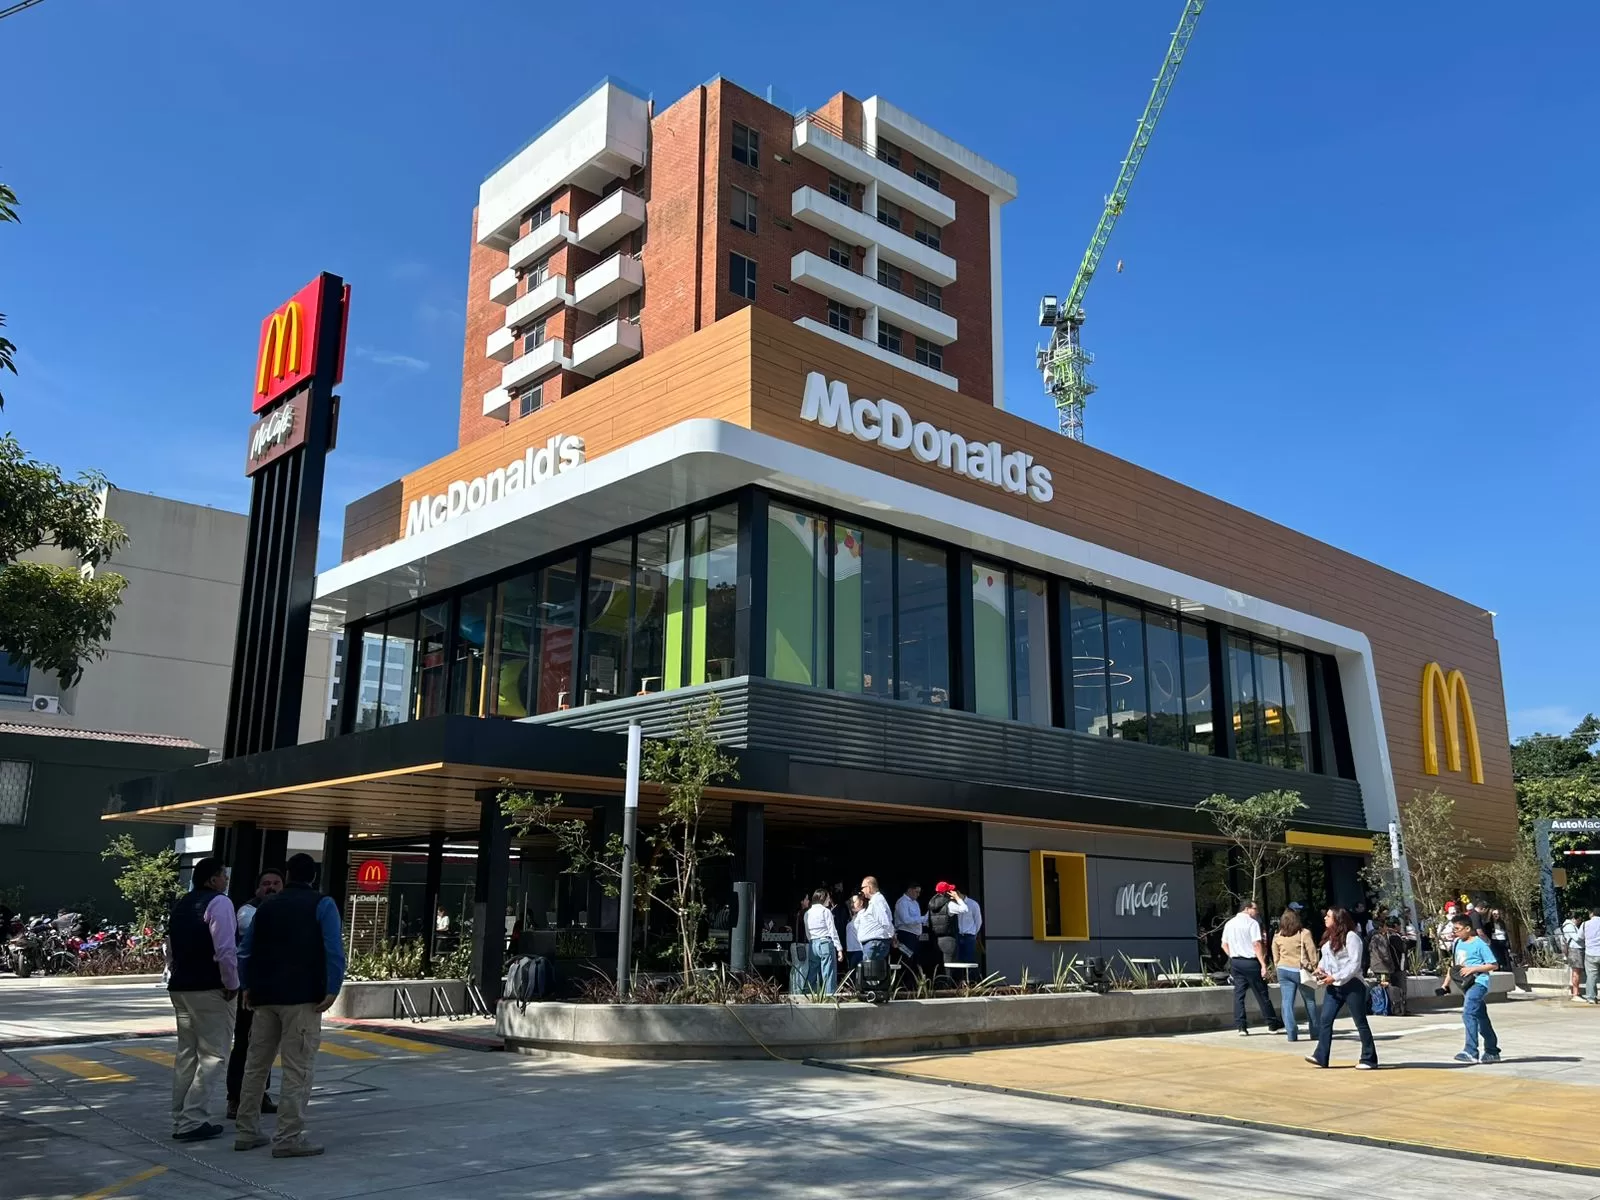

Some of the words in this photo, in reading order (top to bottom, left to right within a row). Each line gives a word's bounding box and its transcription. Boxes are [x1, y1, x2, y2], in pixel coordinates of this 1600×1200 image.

[799, 371, 1054, 503] McDonald's
[404, 433, 585, 539] McDonald's
[1551, 820, 1600, 829] AutoMac
[1118, 881, 1169, 917] McCafé
